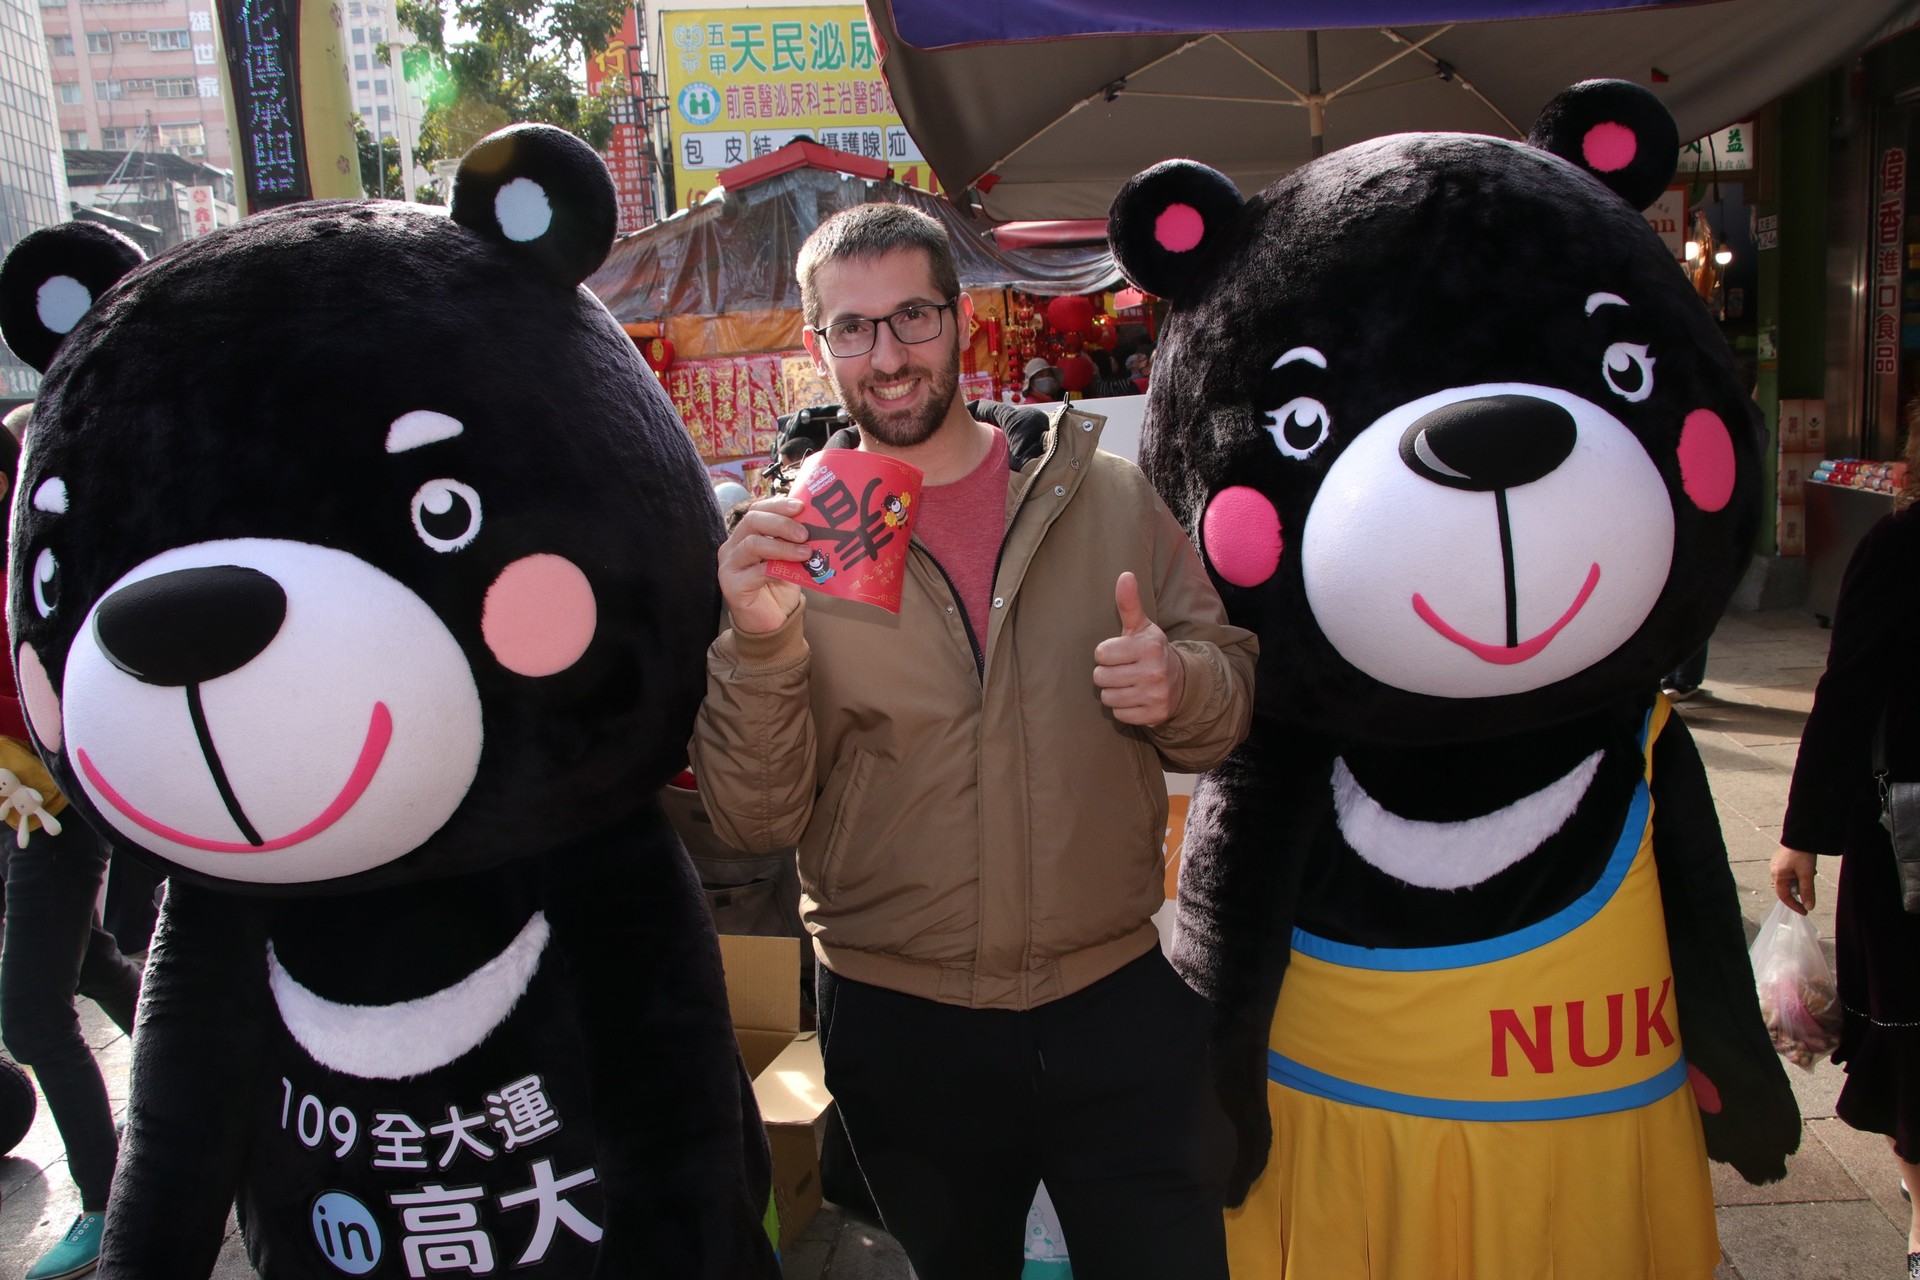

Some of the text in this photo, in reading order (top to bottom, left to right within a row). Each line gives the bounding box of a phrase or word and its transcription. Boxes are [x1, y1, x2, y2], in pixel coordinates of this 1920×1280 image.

[707, 23, 727, 76] 五甲
[730, 21, 877, 73] 天民泌尿
[1489, 976, 1675, 1077] NUK
[281, 1073, 561, 1169] 109全大運
[390, 1157, 603, 1278] 高大
